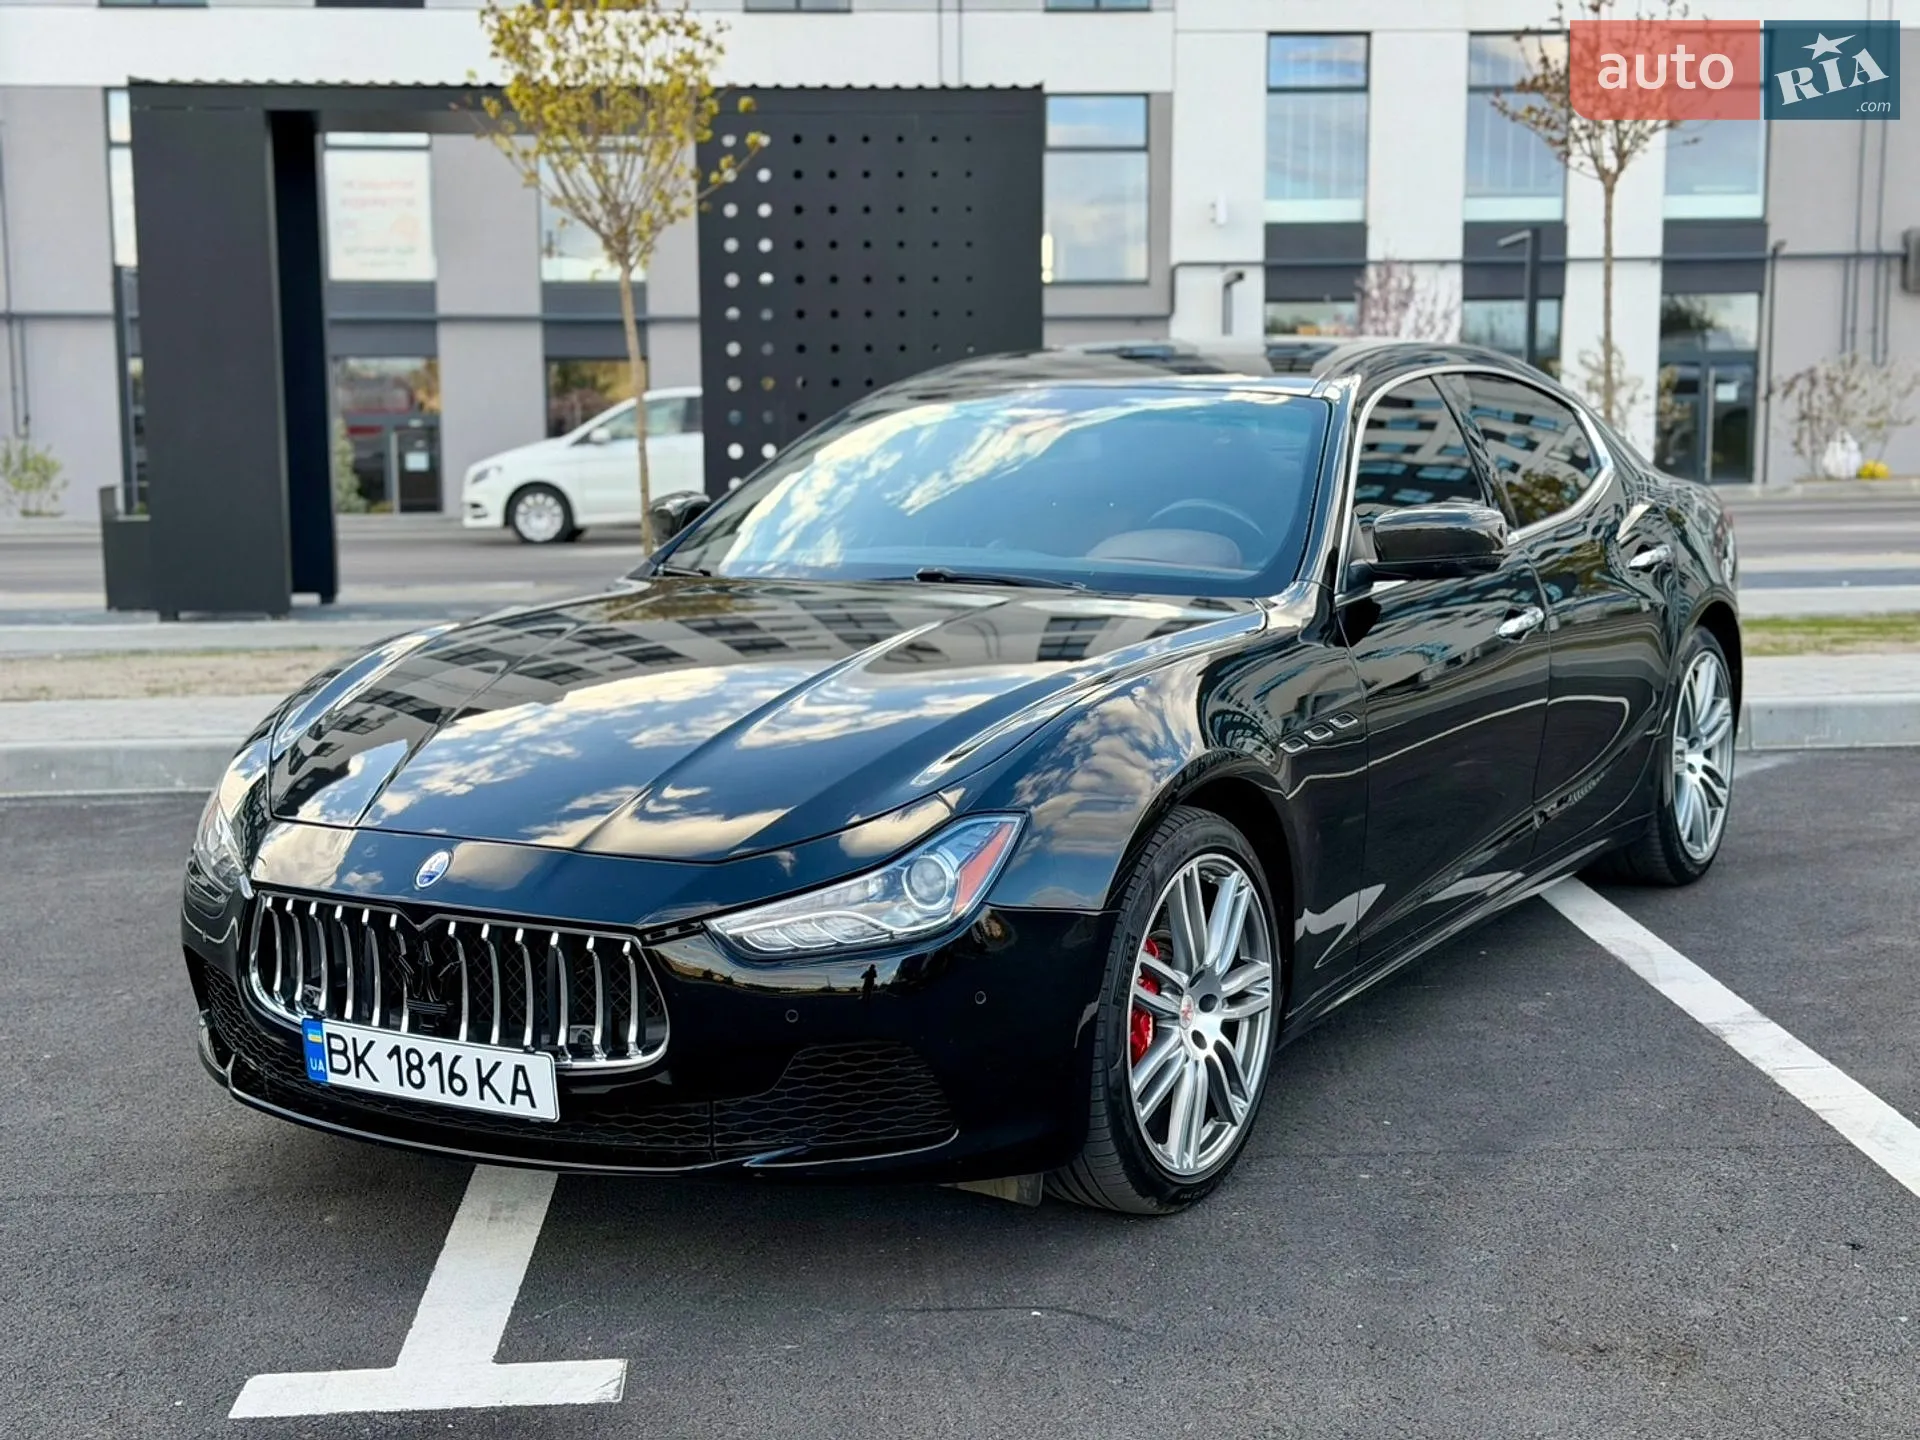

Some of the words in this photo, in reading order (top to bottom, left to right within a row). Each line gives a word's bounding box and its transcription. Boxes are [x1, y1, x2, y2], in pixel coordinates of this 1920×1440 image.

[310, 1059, 325, 1072] UA
[326, 1033, 380, 1083] BK
[387, 1044, 468, 1097] 1816
[476, 1058, 537, 1109] KA
